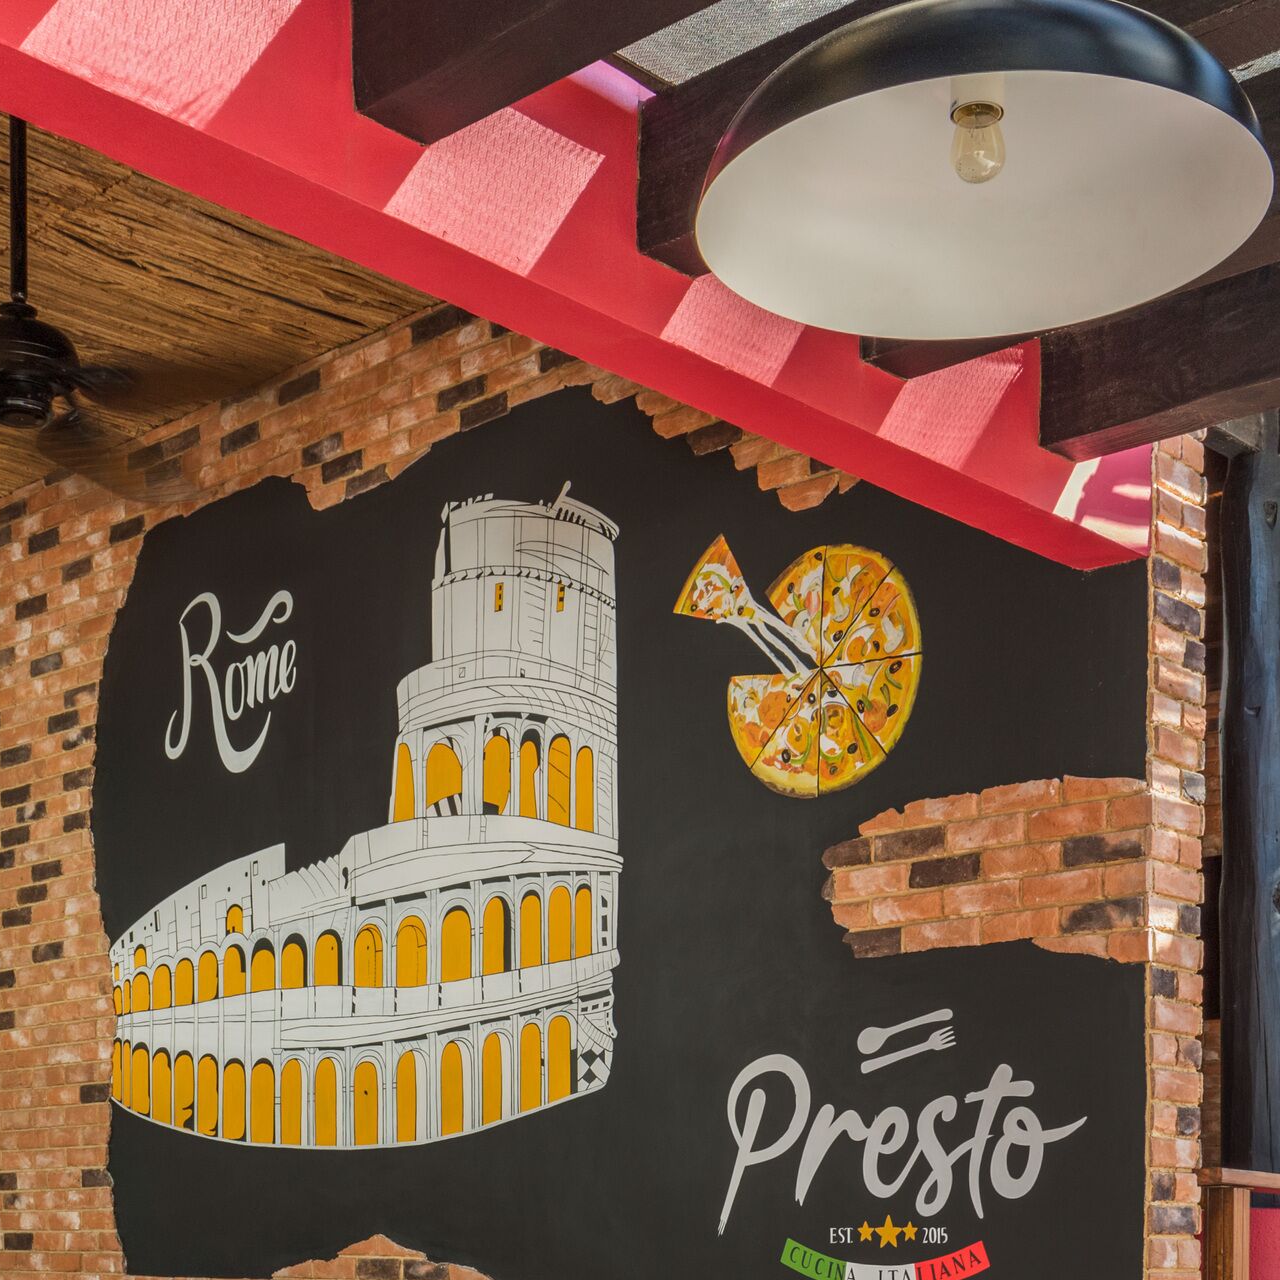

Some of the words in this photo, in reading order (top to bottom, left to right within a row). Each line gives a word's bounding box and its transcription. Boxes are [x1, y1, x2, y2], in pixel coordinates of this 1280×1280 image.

[165, 590, 296, 773] Rome
[718, 1054, 1087, 1237] Presto
[830, 1227, 854, 1244] EST.
[922, 1227, 949, 1244] 2015
